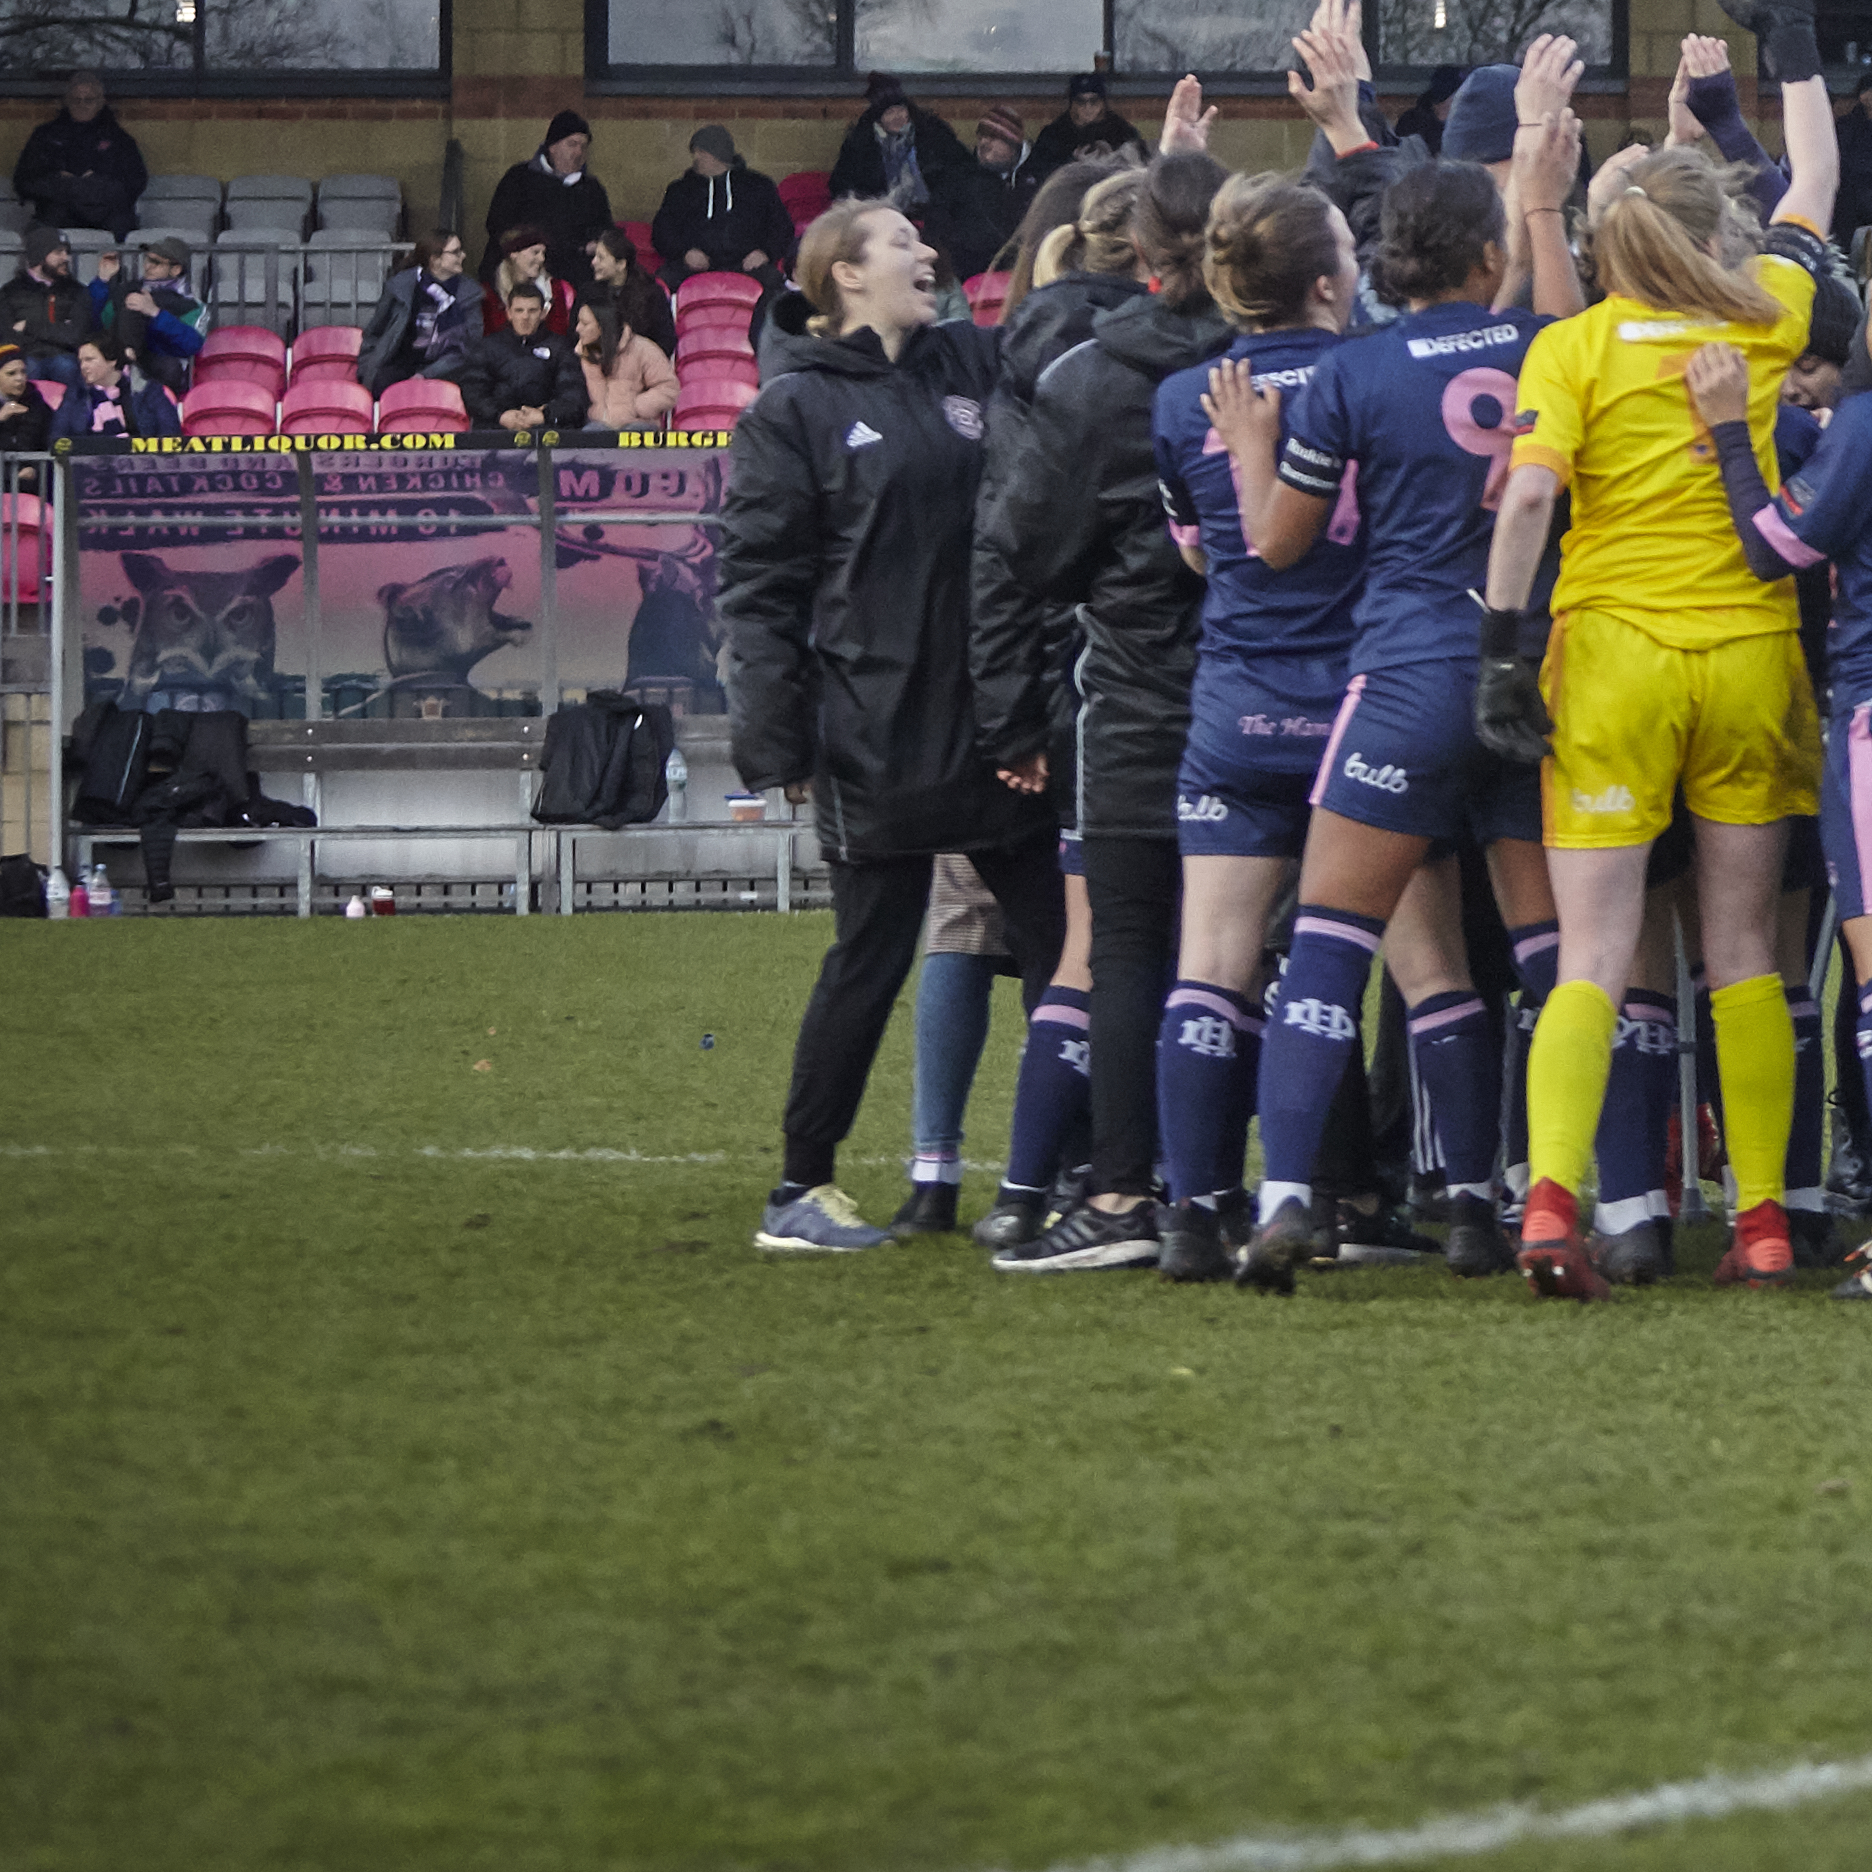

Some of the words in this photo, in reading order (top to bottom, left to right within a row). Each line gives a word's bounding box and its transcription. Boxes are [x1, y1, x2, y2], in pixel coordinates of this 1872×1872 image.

[1424, 323, 1520, 356] DEFECTED
[131, 432, 456, 454] MEATLIQUOR.COM
[1441, 367, 1518, 512] 9
[1344, 751, 1409, 794] bulb
